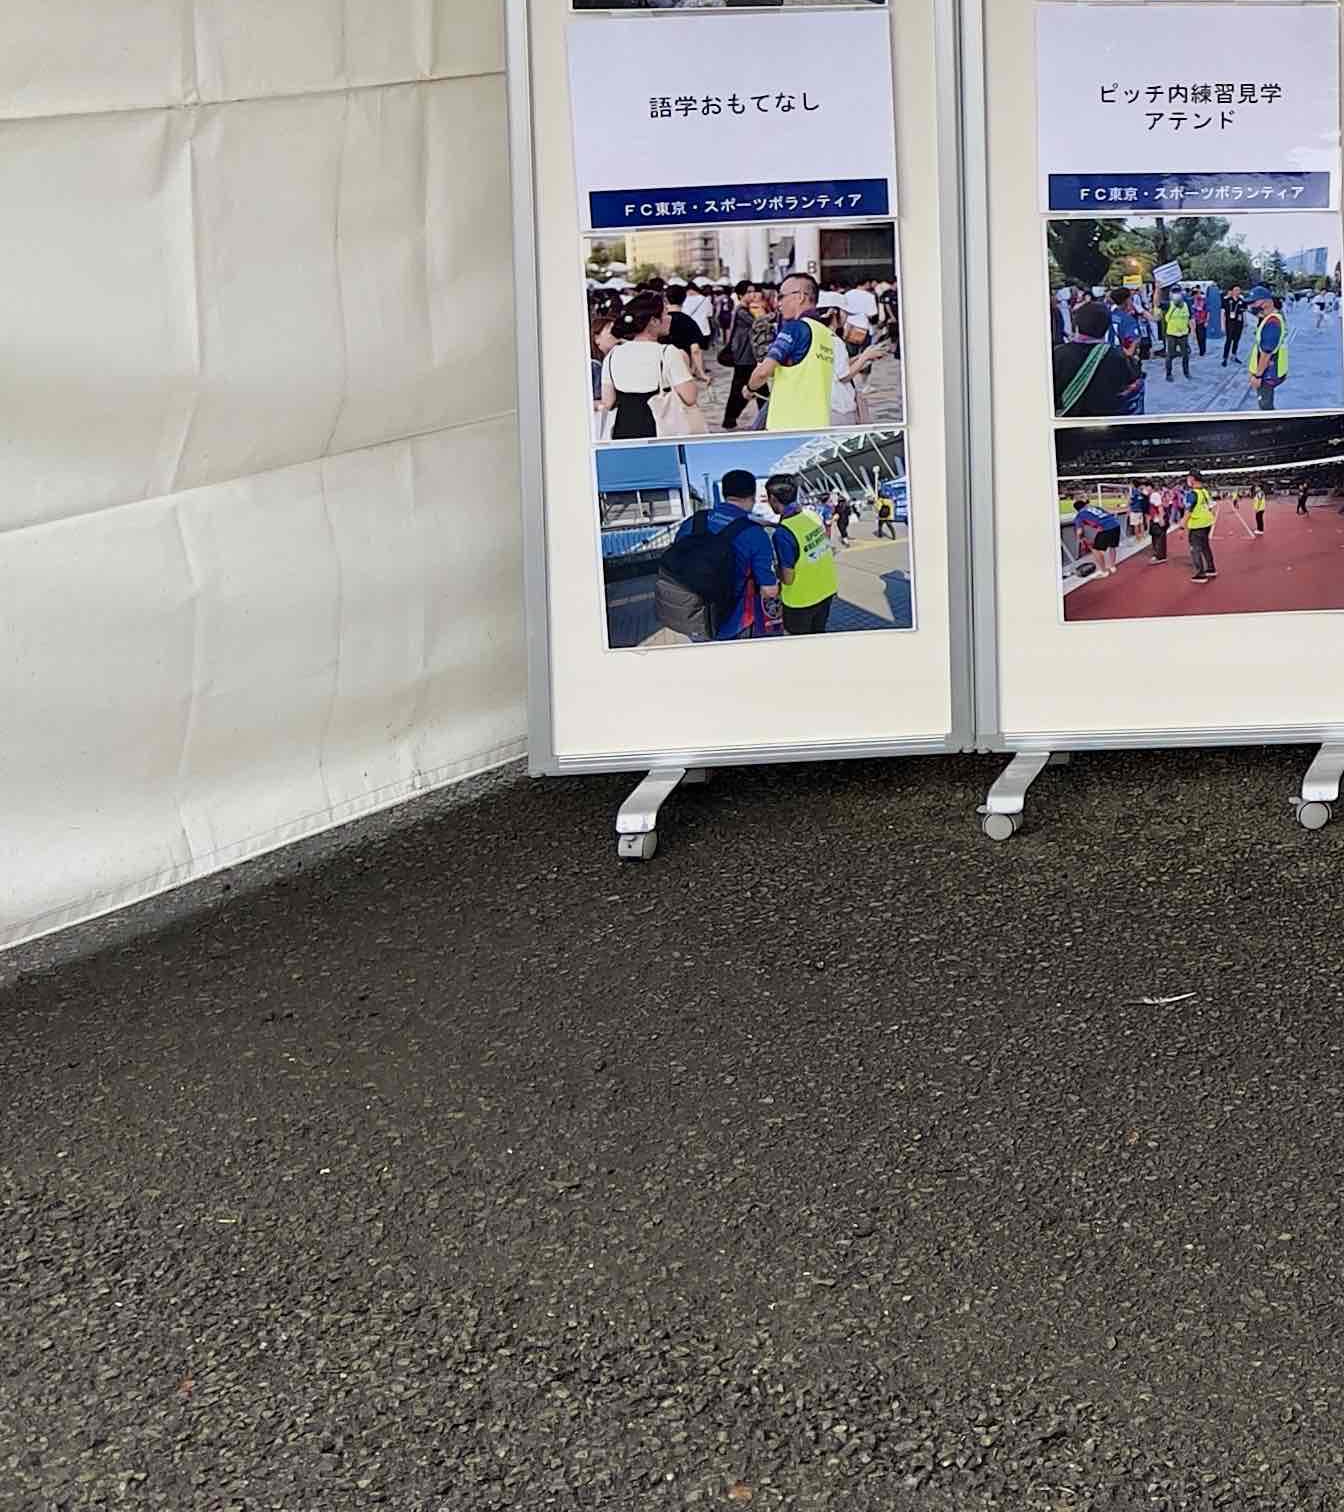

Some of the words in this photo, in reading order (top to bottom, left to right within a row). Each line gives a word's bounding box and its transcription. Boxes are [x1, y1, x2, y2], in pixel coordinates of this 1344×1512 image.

[649, 90, 822, 120] 語学おもてなし
[1099, 82, 1283, 106] ピッチ内練習見学
[1143, 109, 1237, 132] アテンド
